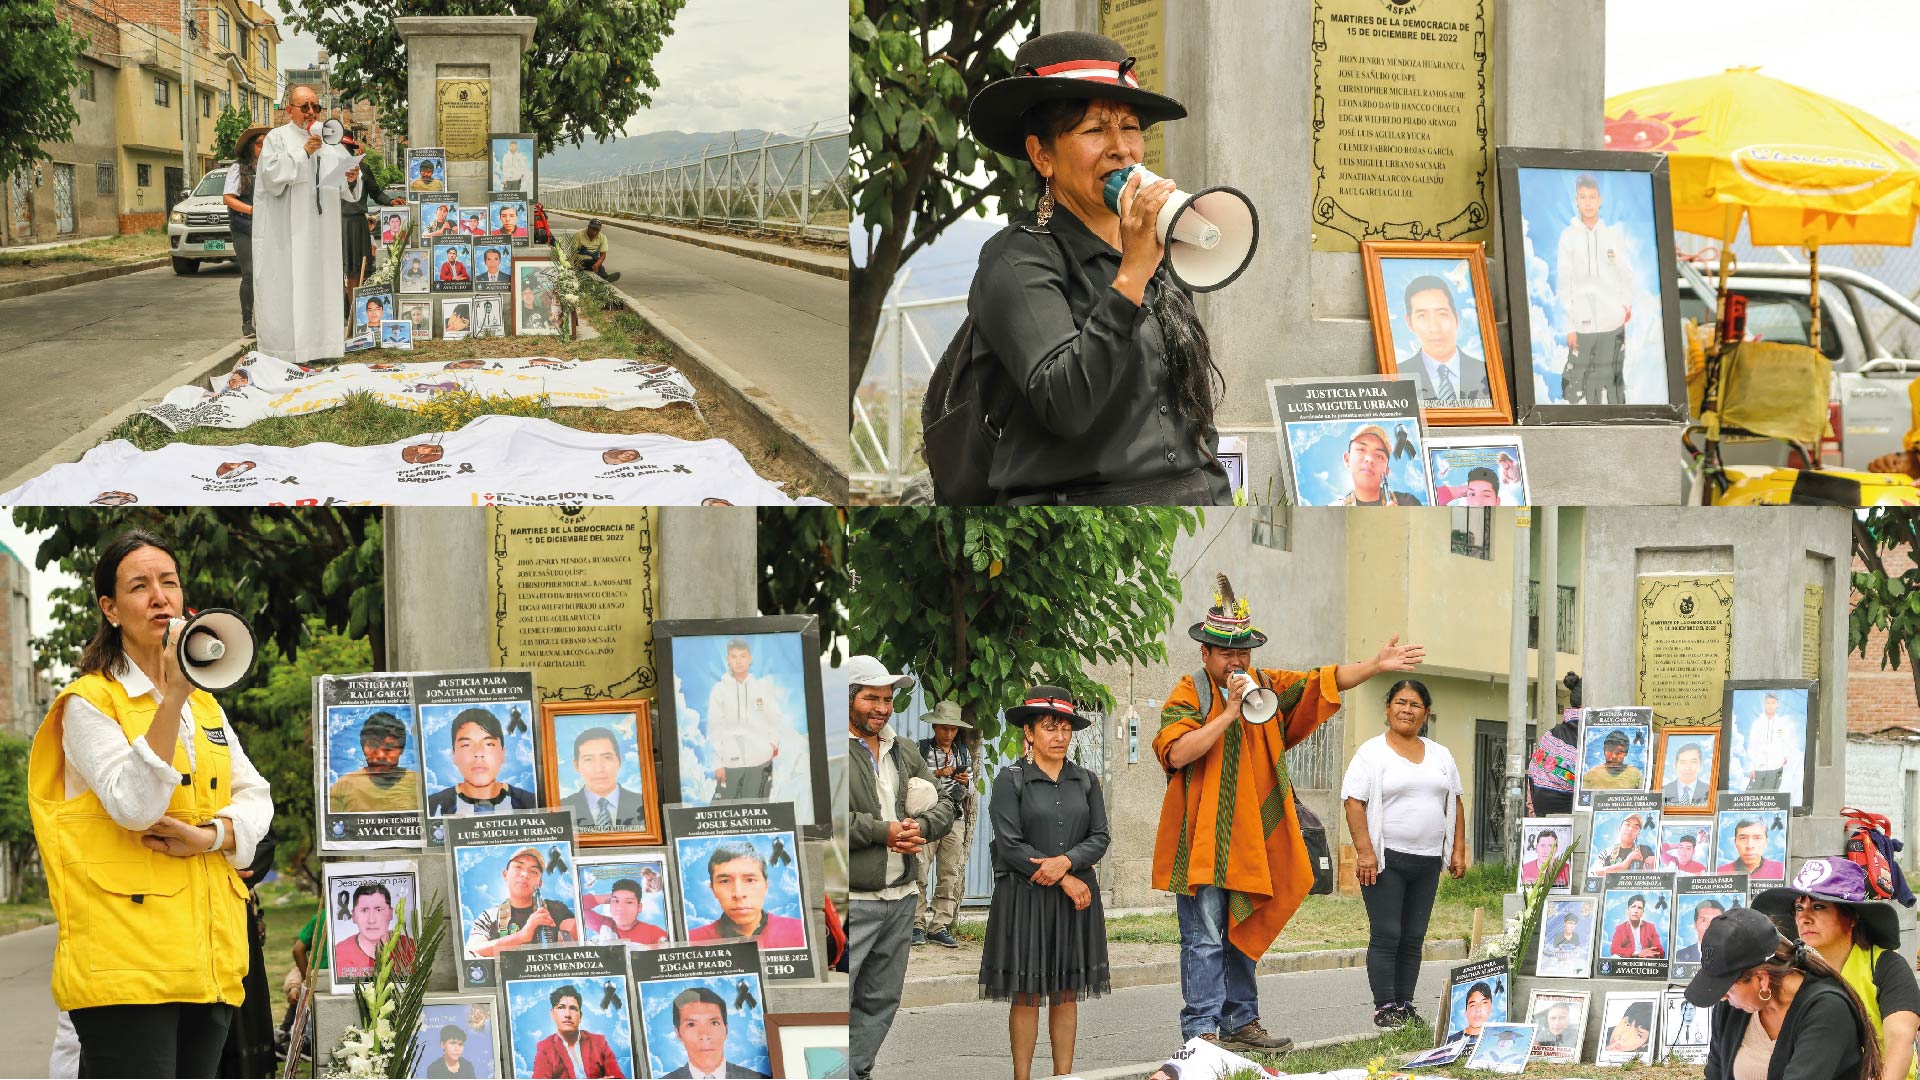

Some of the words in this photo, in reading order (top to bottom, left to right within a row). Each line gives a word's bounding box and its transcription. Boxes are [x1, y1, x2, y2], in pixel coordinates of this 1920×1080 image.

[1386, 3, 1417, 15] ASFAH
[1331, 14, 1374, 25] MARTIRES
[1376, 17, 1387, 25] DE
[1389, 18, 1400, 26] LA
[1402, 19, 1457, 30] DEMOCRACIA
[1459, 23, 1470, 31] DE
[1347, 27, 1357, 35] 15
[1359, 28, 1370, 36] DE
[1372, 29, 1418, 40] DICIEMBRE
[1420, 32, 1435, 41] DEL
[1438, 33, 1458, 42] 2022
[1338, 55, 1357, 63] JHON
[1387, 58, 1421, 68] MENDOZA
[1361, 71, 1390, 81] SAÑUDO
[1391, 72, 1416, 82] QUISPE
[1338, 85, 1388, 95] CHRISTOPHER
[1389, 87, 1422, 97] MICHAEL
[1423, 89, 1448, 98] RAMOS
[1338, 99, 1378, 109] LEONARDO
[1379, 101, 1400, 110] DAVID
[1338, 114, 1363, 122] EDGAR
[1365, 115, 1402, 125] WILFREDO
[1403, 116, 1427, 126] PRADO
[1427, 118, 1457, 127] ARANGO
[1357, 129, 1374, 137] LUIS
[1375, 130, 1405, 140] AGUILAR
[1406, 131, 1431, 141] YUCRA
[1370, 144, 1403, 154] FABRICIO
[1404, 146, 1425, 155] ROJAS
[1339, 157, 1355, 166] LUIS
[1357, 158, 1384, 168] MIGUEL
[1385, 160, 1414, 169] URBANO
[1415, 161, 1446, 170] SACSARA
[1339, 172, 1378, 182] JONATHAN
[1412, 175, 1444, 184] GALINDO
[1306, 388, 1357, 399] JUSTICIA
[1358, 387, 1388, 397] PARA
[1288, 402, 1314, 413] LUIS
[1316, 400, 1362, 412] MIGUEL
[1363, 398, 1409, 410] URBANO
[510, 526, 548, 535] MARTIRES
[551, 526, 560, 534] DE
[562, 525, 572, 533] LA
[573, 524, 623, 533] DEMOCRACIA
[625, 523, 635, 531] DE
[535, 536, 545, 544] DE
[546, 535, 589, 543] DICIEMBRE
[590, 534, 605, 542] DEL
[347, 681, 389, 689] JUSTICIA
[391, 680, 409, 688] PAR
[438, 678, 481, 687] JUSTICIA
[482, 676, 507, 685] PARA
[350, 689, 375, 699] RAÚL
[376, 688, 412, 698] GARCÍA
[426, 688, 476, 698] JONATHAN
[478, 686, 523, 695] ALARCON
[377, 816, 423, 824] DICIEMBRE
[695, 809, 741, 820] JUSTICIA
[741, 808, 768, 817] PARA
[474, 820, 518, 829] JUSTICIA
[520, 818, 546, 826] PARA
[697, 820, 728, 830] JOSUE
[730, 817, 771, 827] SAÑUDO
[356, 825, 424, 837] AYACUCHO
[457, 831, 480, 840] LUIS
[482, 829, 519, 838] MIGUEL
[523, 826, 564, 836] URBANO
[379, 877, 391, 886] en
[526, 952, 572, 963] JUSTICIA
[573, 950, 600, 960] PARA
[657, 951, 703, 962] JUSTICIA
[705, 949, 732, 958] PARA
[524, 963, 552, 973] JHON
[553, 961, 604, 971] MENDOZA
[660, 963, 695, 973] EDGAR
[697, 959, 733, 969] PRADO
[1615, 967, 1659, 975] AYACUCHO
